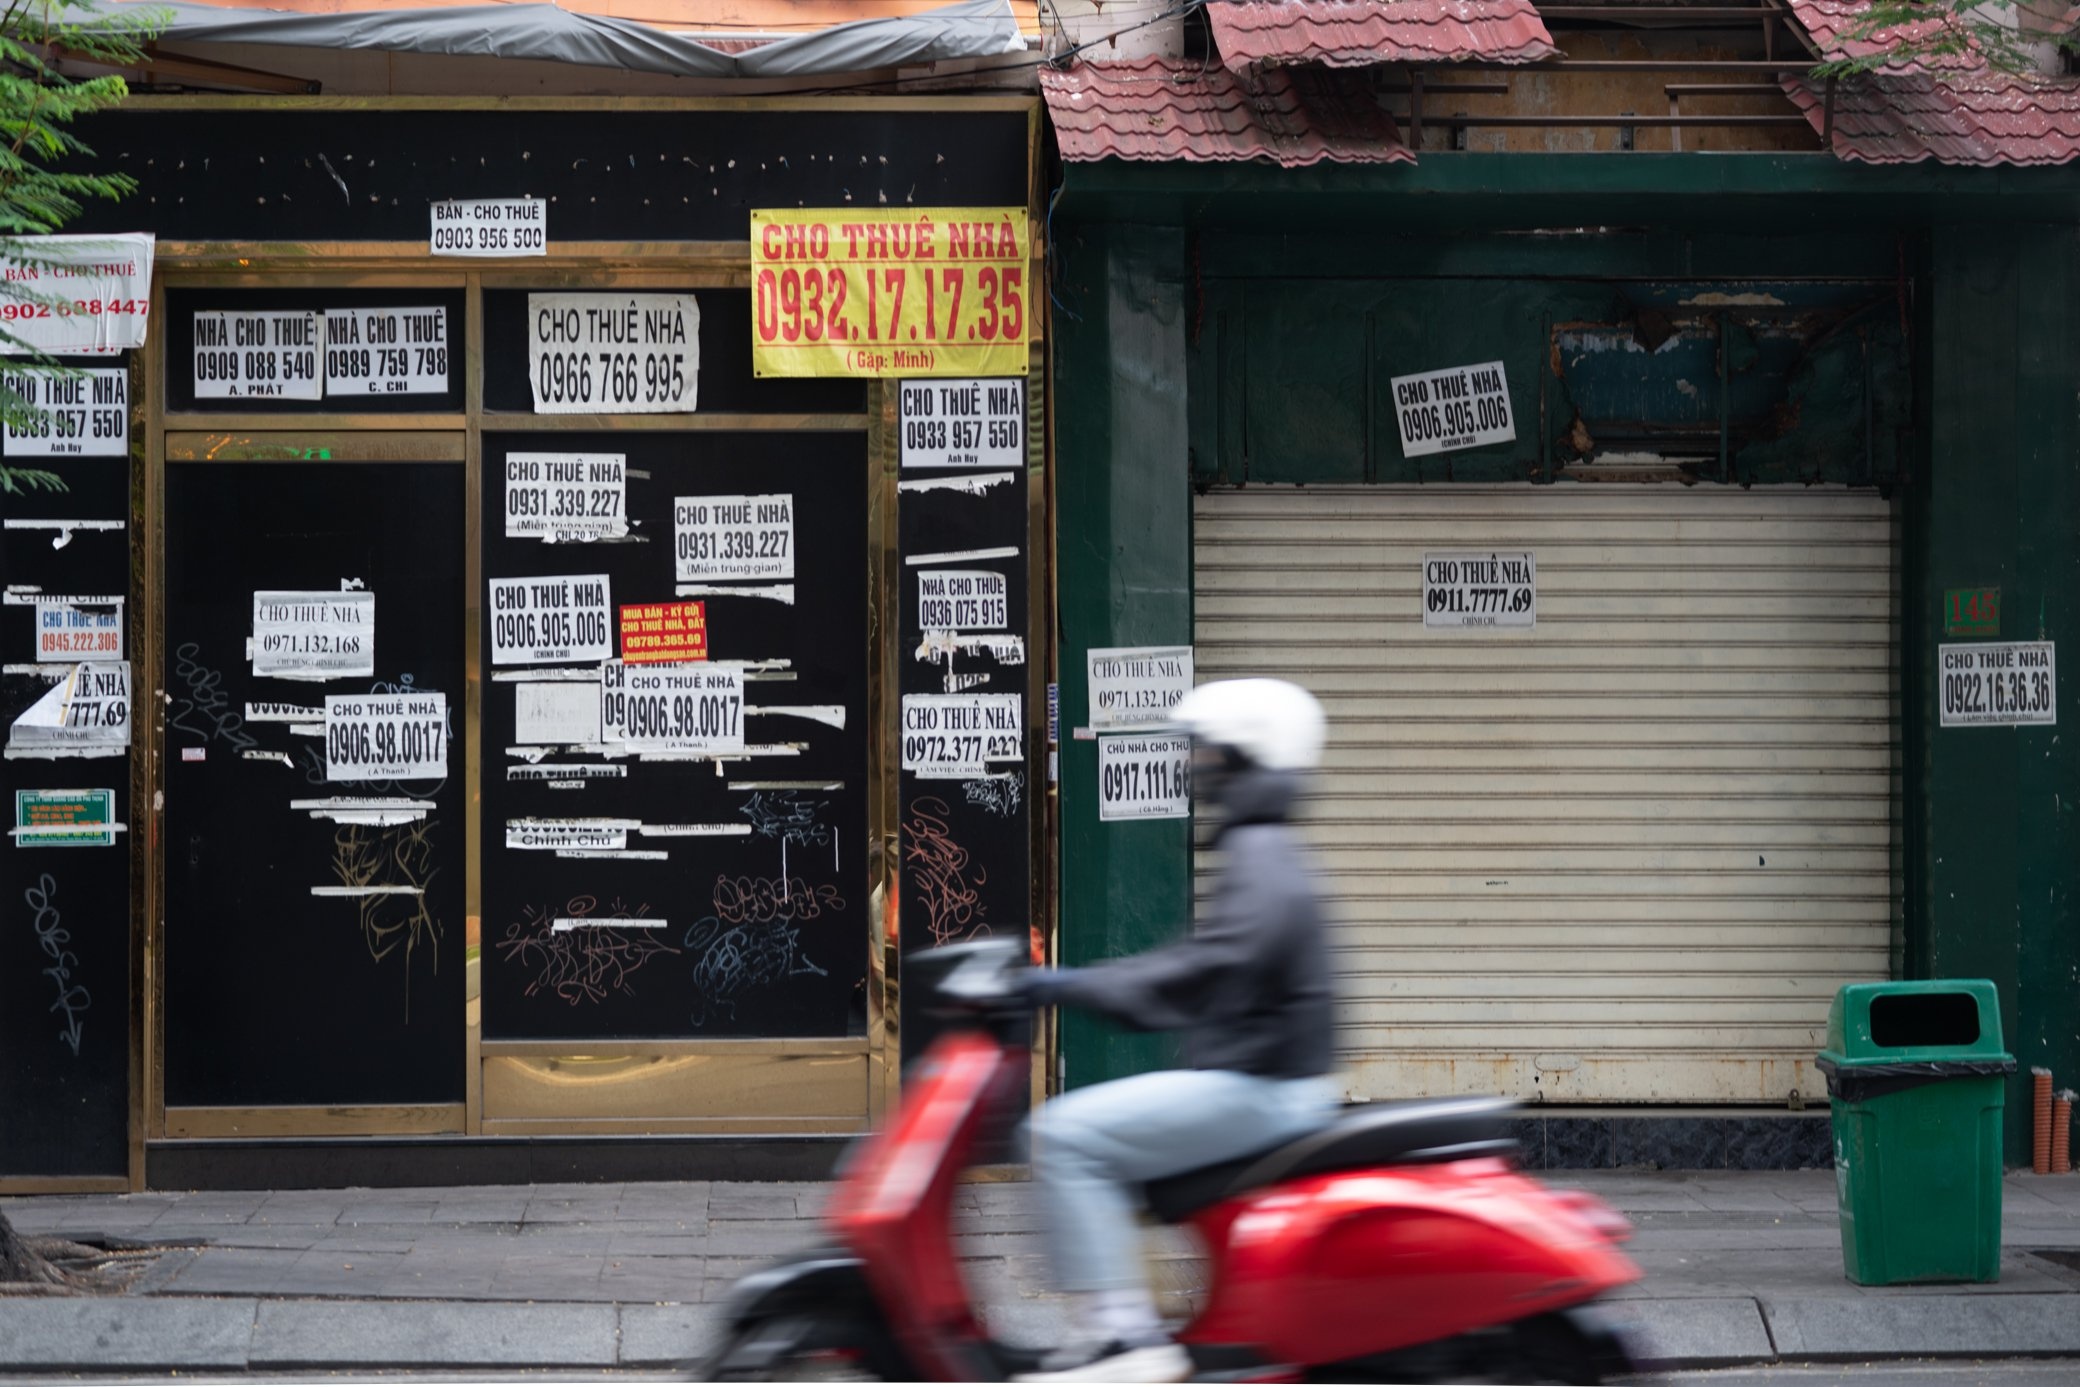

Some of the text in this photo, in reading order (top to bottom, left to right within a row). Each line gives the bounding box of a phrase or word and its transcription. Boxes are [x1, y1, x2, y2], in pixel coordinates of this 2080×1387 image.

[437, 201, 462, 220] BÁN
[474, 205, 501, 220] CHO
[505, 201, 539, 220] THUÊ
[435, 227, 542, 249] 0903 956 500
[762, 213, 1019, 260] CHO THUÊ NHÀ
[107, 299, 149, 317] 447
[757, 266, 1023, 342] 0932.17.17.35
[196, 312, 314, 346] NHÀ CHO THUÊ
[328, 308, 444, 345] NHÀ CHO THUÊ
[538, 299, 686, 344] CHO THUÊ NHÀ
[197, 351, 315, 381] 0909 088 540
[328, 347, 446, 378] 0989 759 798
[92, 370, 125, 404] NHÀ
[540, 352, 684, 403] 0966 766 995
[1397, 366, 1502, 406] CHO THUÊ NHÀ
[903, 381, 1020, 417] CHO THUÊ NHÀ
[56, 409, 87, 438] 957
[92, 409, 123, 438] 550
[1402, 395, 1508, 442] 0906.905.006
[51, 443, 82, 454] Anh Huy
[907, 420, 1018, 449] 0933 957 550
[507, 458, 622, 482] CHO THUÊ NHÀ
[947, 453, 979, 464] Anh Huy
[509, 488, 621, 517] 0931.339.227
[676, 499, 790, 525] CHO THUÊ NHÀ
[678, 530, 789, 560] 0931.339.227
[721, 564, 751, 575] trung
[1427, 553, 1532, 584] CHO THUÊ NHÀ
[495, 579, 604, 610] CHO THUÊ NHÀ
[922, 574, 972, 596] NHÀ CHO
[260, 600, 360, 622] CHO THUÊ NHÀ
[623, 608, 643, 620] MUA
[644, 605, 663, 619] BÁN
[922, 598, 1004, 626] 0936 075 915
[1427, 587, 1532, 613] 0911.7777.69
[1951, 593, 1996, 622] 145
[496, 611, 606, 648] 0906.905.006
[621, 621, 639, 632] CHO
[641, 618, 663, 632] THUÊ
[42, 632, 118, 651] 0945.222.306
[264, 634, 360, 654] 0971.132.168
[1093, 655, 1183, 678] CHO THUÊ NHÀ
[1944, 647, 2049, 669] CHO THUÊ NHÀ
[95, 667, 126, 697] NHÀ
[631, 672, 735, 689] CHO THUÊ NHÀ
[1945, 671, 2050, 714] 0922.16.36.36
[332, 703, 362, 716] CHO
[367, 698, 404, 716] THUÊ
[409, 698, 437, 715] NHÀ
[1099, 690, 1183, 709] 0971.132.168
[627, 695, 740, 738] 0906.98.0017
[907, 706, 938, 730] CHO
[942, 699, 981, 730] THUÊ
[985, 699, 1016, 730] NHÀ
[329, 721, 442, 765] 0906.98.0017
[1107, 740, 1125, 754] CHỦ
[1128, 740, 1147, 753] NHÀ
[1150, 742, 1168, 753] CHO
[521, 834, 571, 846] Chính
